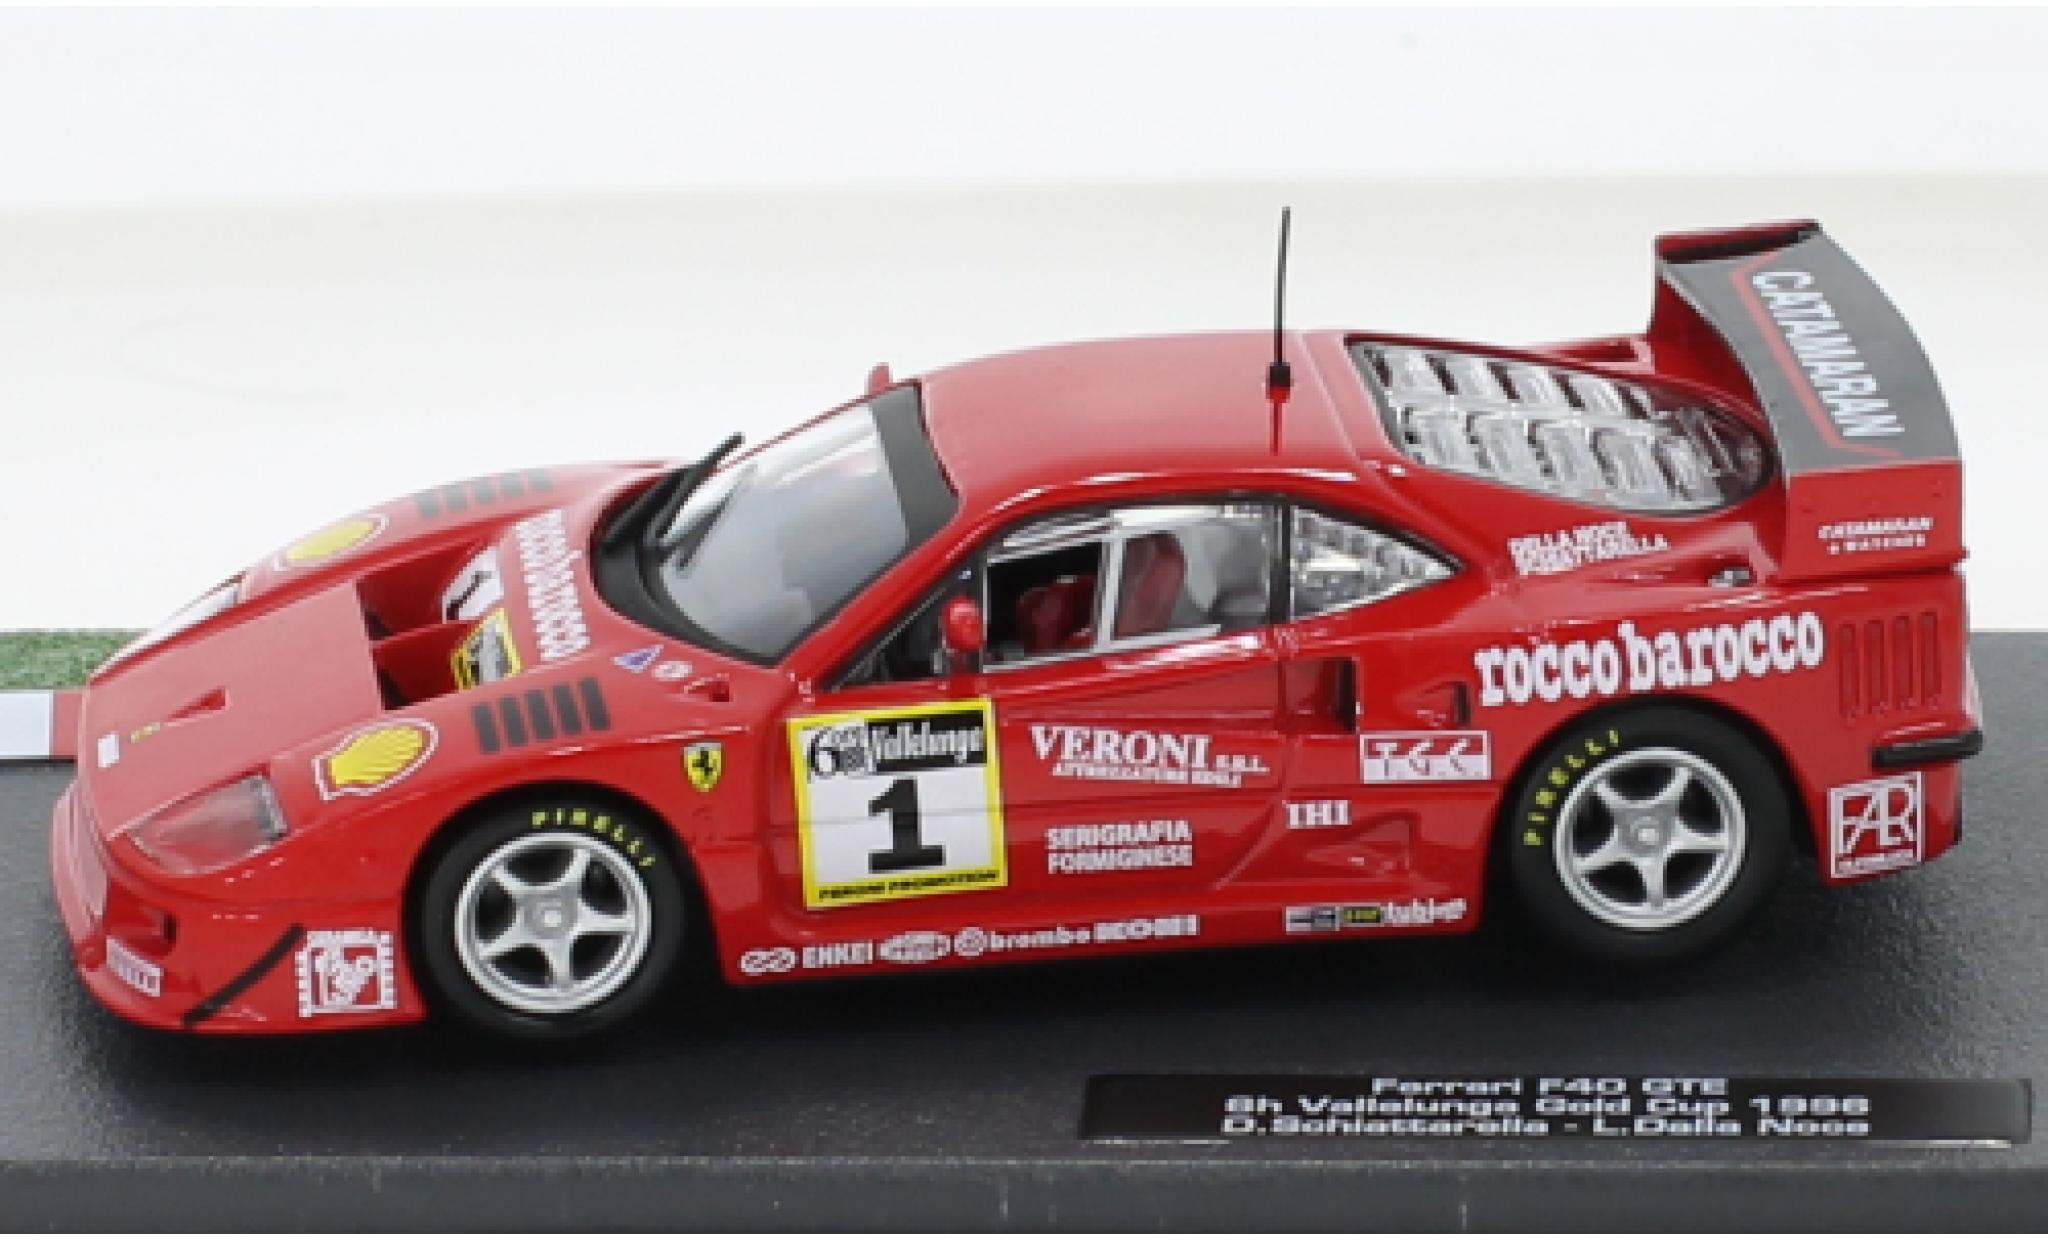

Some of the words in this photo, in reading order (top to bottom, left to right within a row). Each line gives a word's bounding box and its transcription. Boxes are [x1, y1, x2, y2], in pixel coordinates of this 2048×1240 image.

[1752, 269, 1906, 438] CATAMARAN
[1029, 724, 1213, 771] VERONI
[1522, 728, 1622, 848] PIRELLI
[531, 807, 656, 868] PIRELLI
[866, 777, 946, 874] 1
[1285, 799, 1351, 830] IHI
[989, 925, 1091, 952] brembo
[1371, 1077, 1521, 1096] Ferrari
[1539, 1077, 1627, 1096] F40
[1641, 1077, 1729, 1096] GTE
[1535, 1095, 1631, 1116] Gold
[1646, 1096, 1729, 1119] Cup
